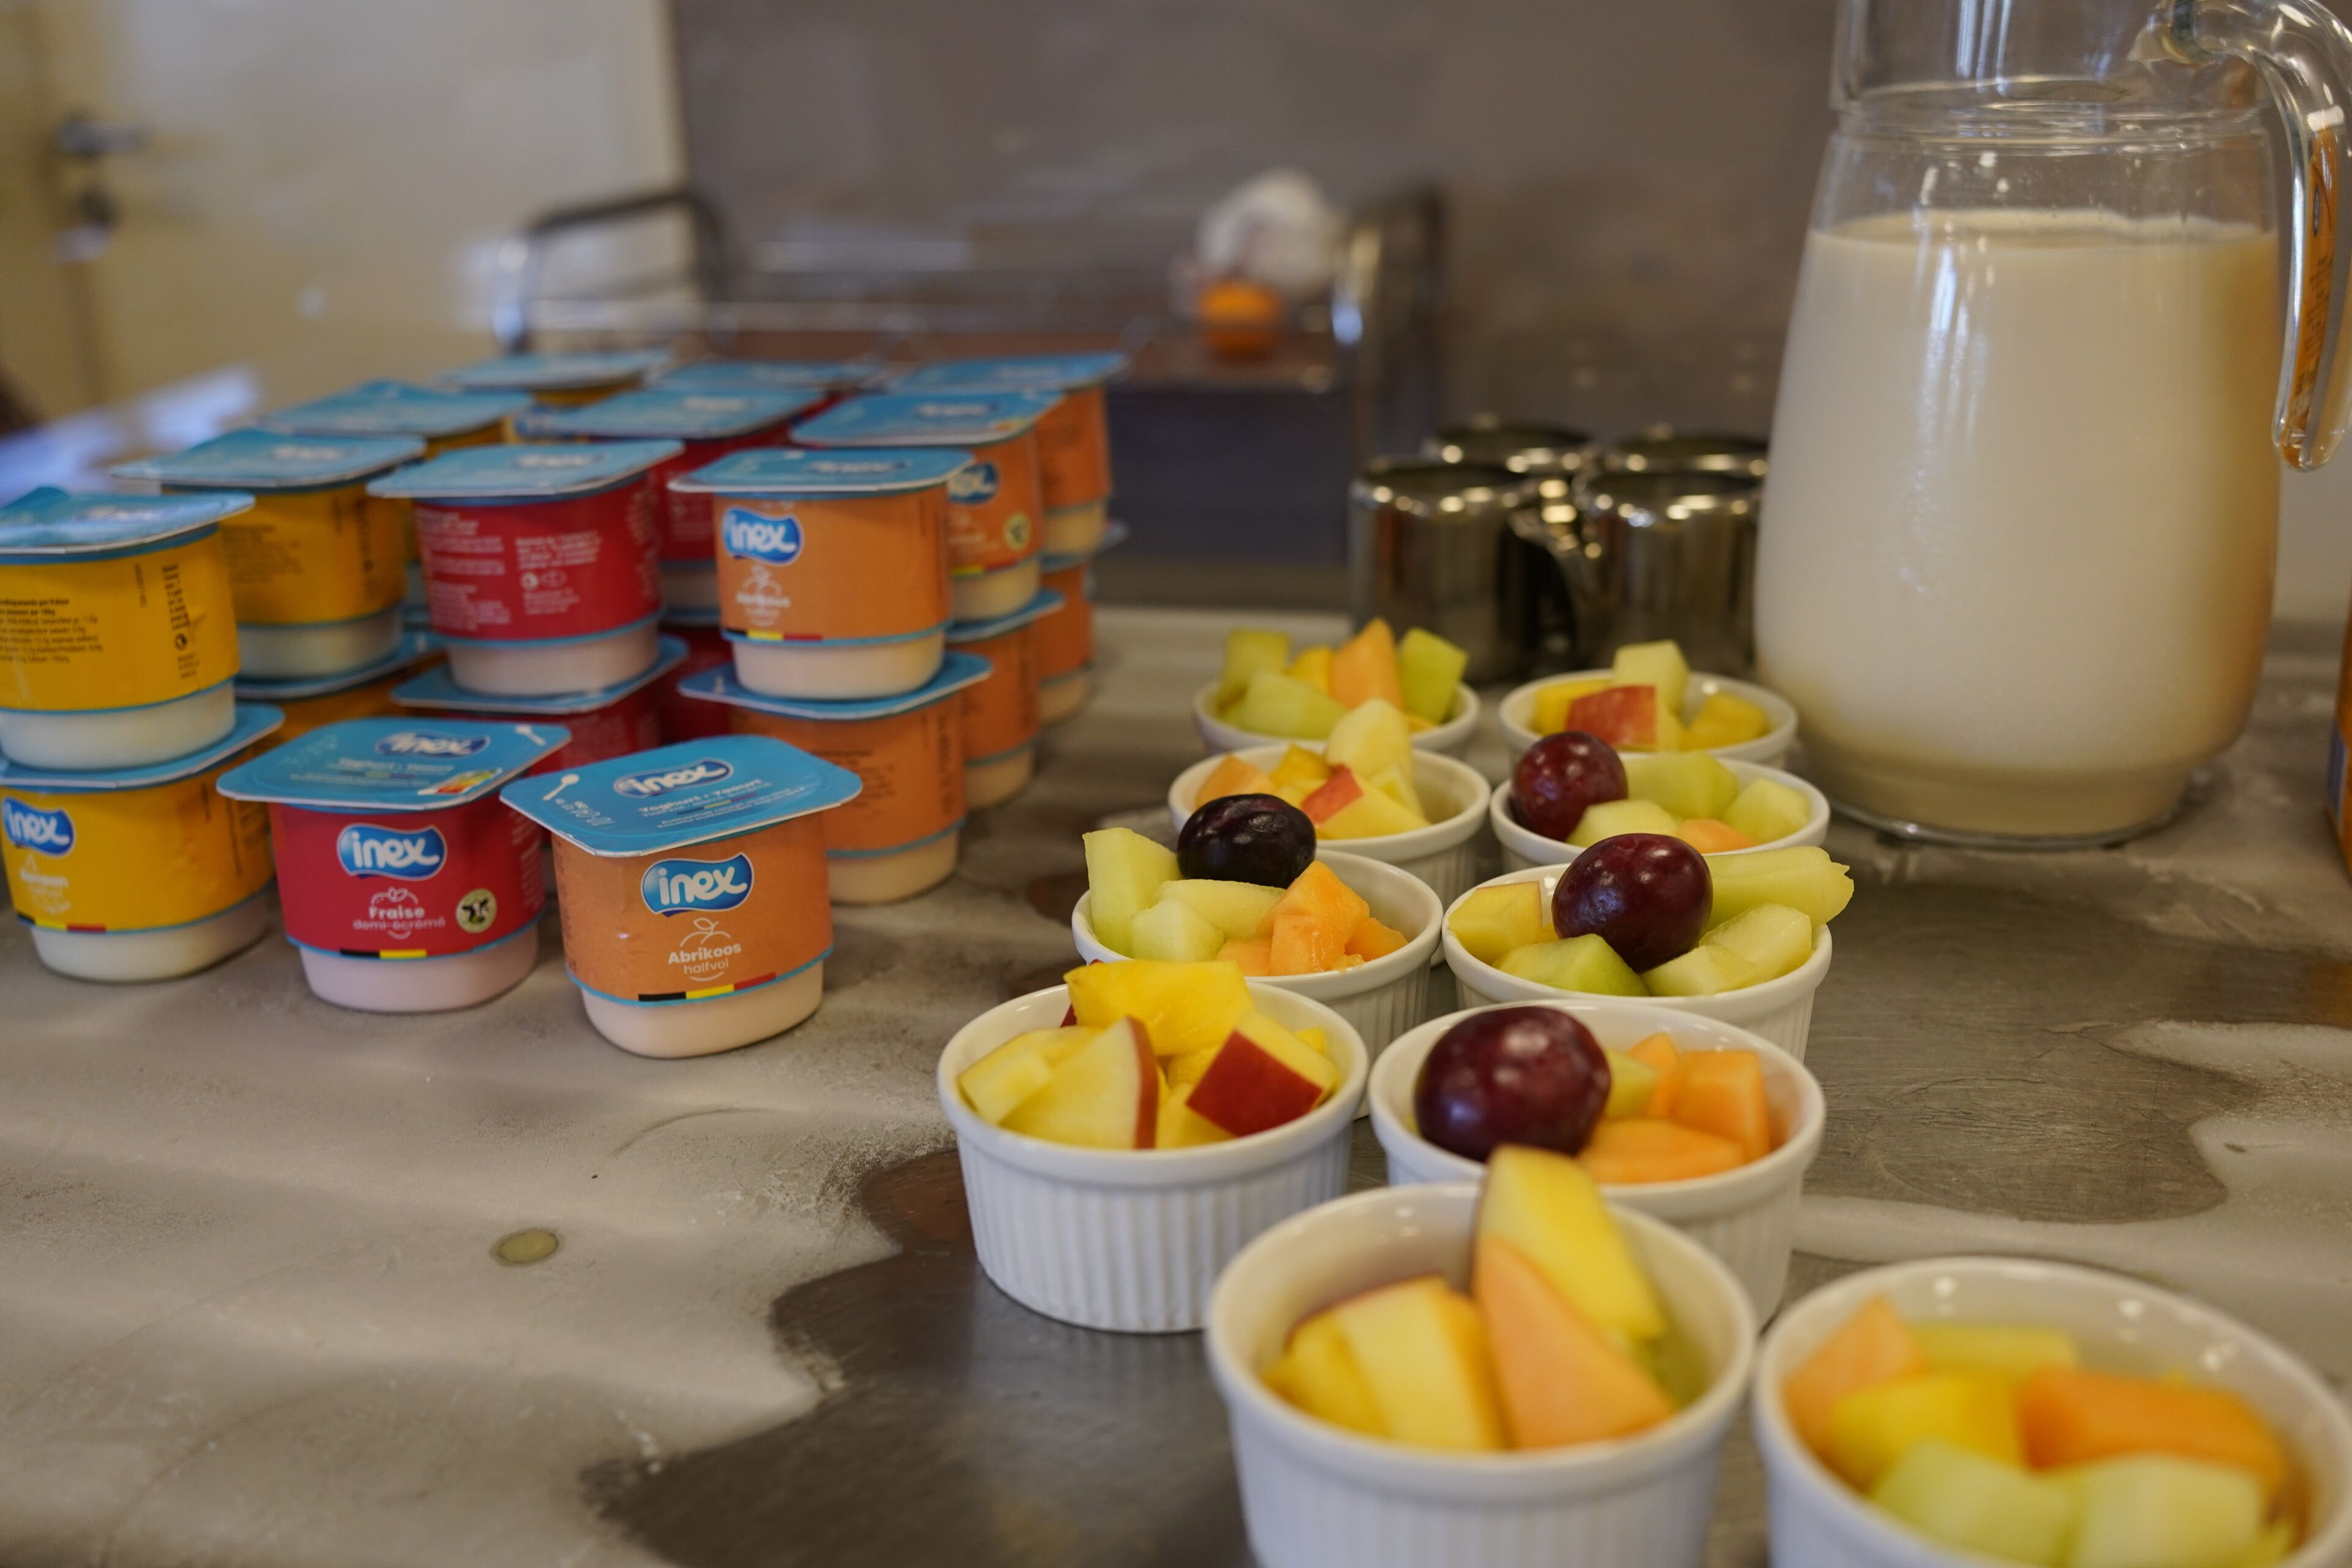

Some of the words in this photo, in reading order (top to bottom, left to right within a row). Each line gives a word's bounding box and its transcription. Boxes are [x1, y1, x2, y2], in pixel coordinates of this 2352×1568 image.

[726, 513, 796, 554] inex
[625, 764, 728, 794] inex
[3, 801, 70, 846] inex
[352, 831, 440, 869] inex
[658, 866, 748, 905] inex
[369, 905, 425, 919] Fraise
[668, 943, 742, 964] Abrikoos
[684, 958, 729, 974] halfvol
